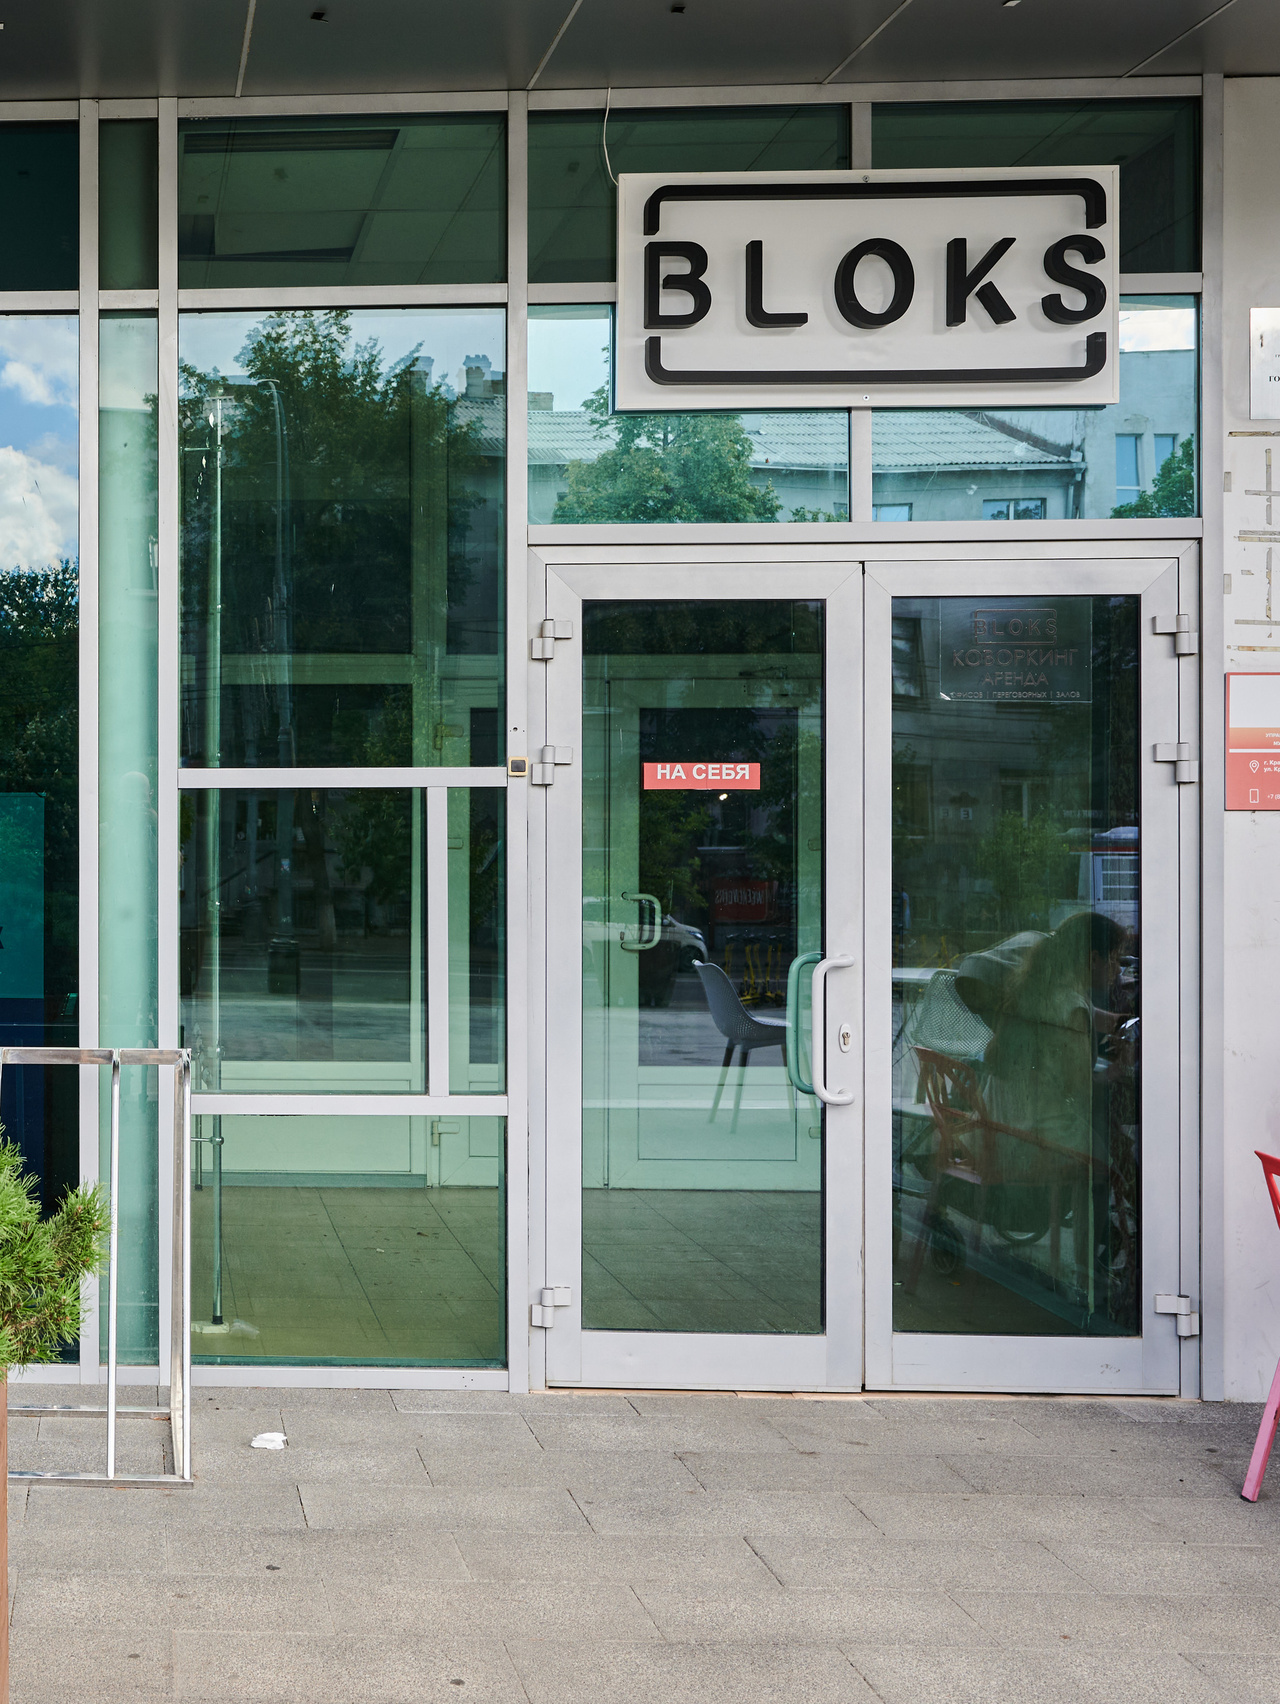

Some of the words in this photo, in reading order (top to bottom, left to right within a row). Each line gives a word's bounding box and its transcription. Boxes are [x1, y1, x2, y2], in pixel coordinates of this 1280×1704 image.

[644, 234, 1107, 330] BLOKS
[974, 618, 1057, 636] BLOKS
[953, 649, 1078, 667] КОВОРКИНГ
[982, 671, 1049, 687] АРЕНДА
[950, 691, 983, 699] ОФИСОВ
[992, 691, 1047, 699] ПЕРЕГОВОРНЫХ
[657, 764, 686, 780] НА
[692, 764, 749, 780] СЕБЯ
